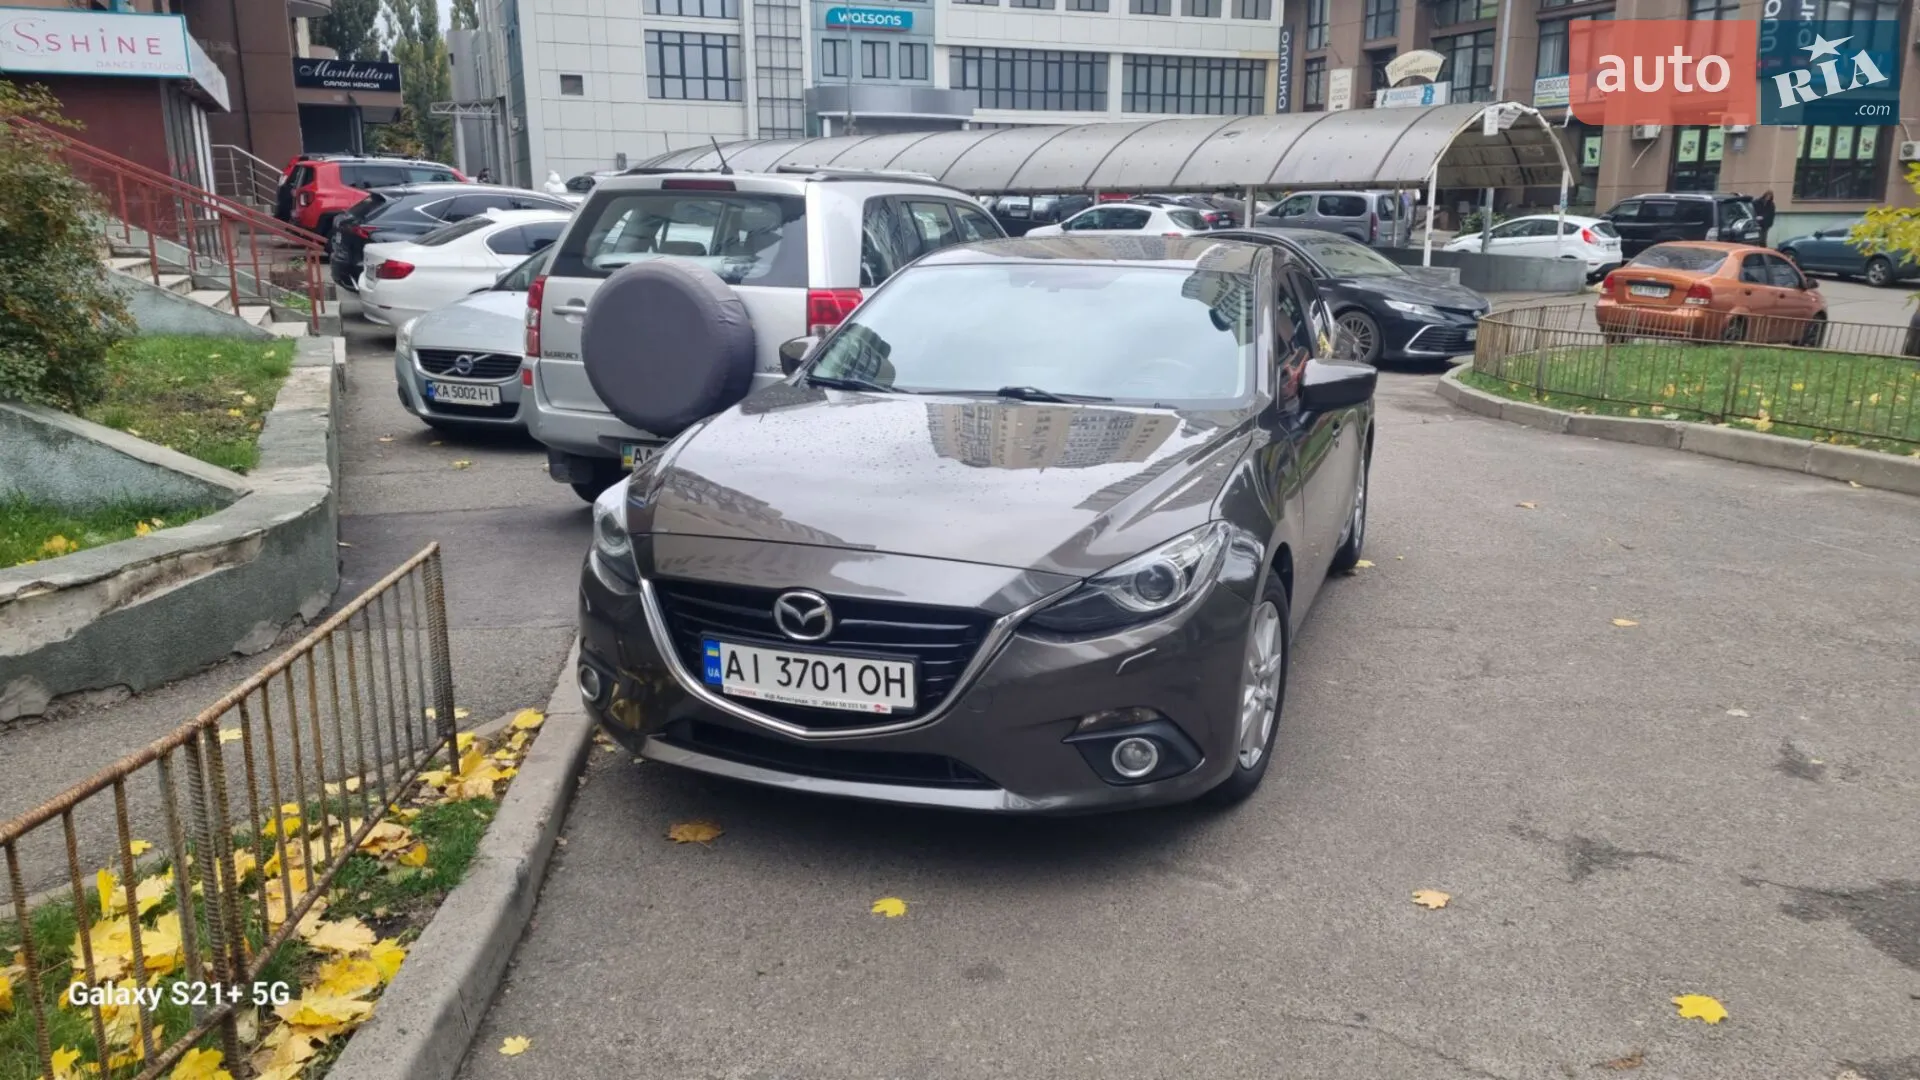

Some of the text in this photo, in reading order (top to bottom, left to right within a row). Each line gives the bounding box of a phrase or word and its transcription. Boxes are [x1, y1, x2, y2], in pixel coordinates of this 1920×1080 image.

[837, 12, 902, 26] watsons
[96, 60, 185, 71] DANCE STUDIO
[299, 60, 394, 80] Manhattan
[434, 384, 494, 401] KA 5002 HI
[707, 667, 721, 678] UA
[725, 650, 907, 699] AI 3701 OH
